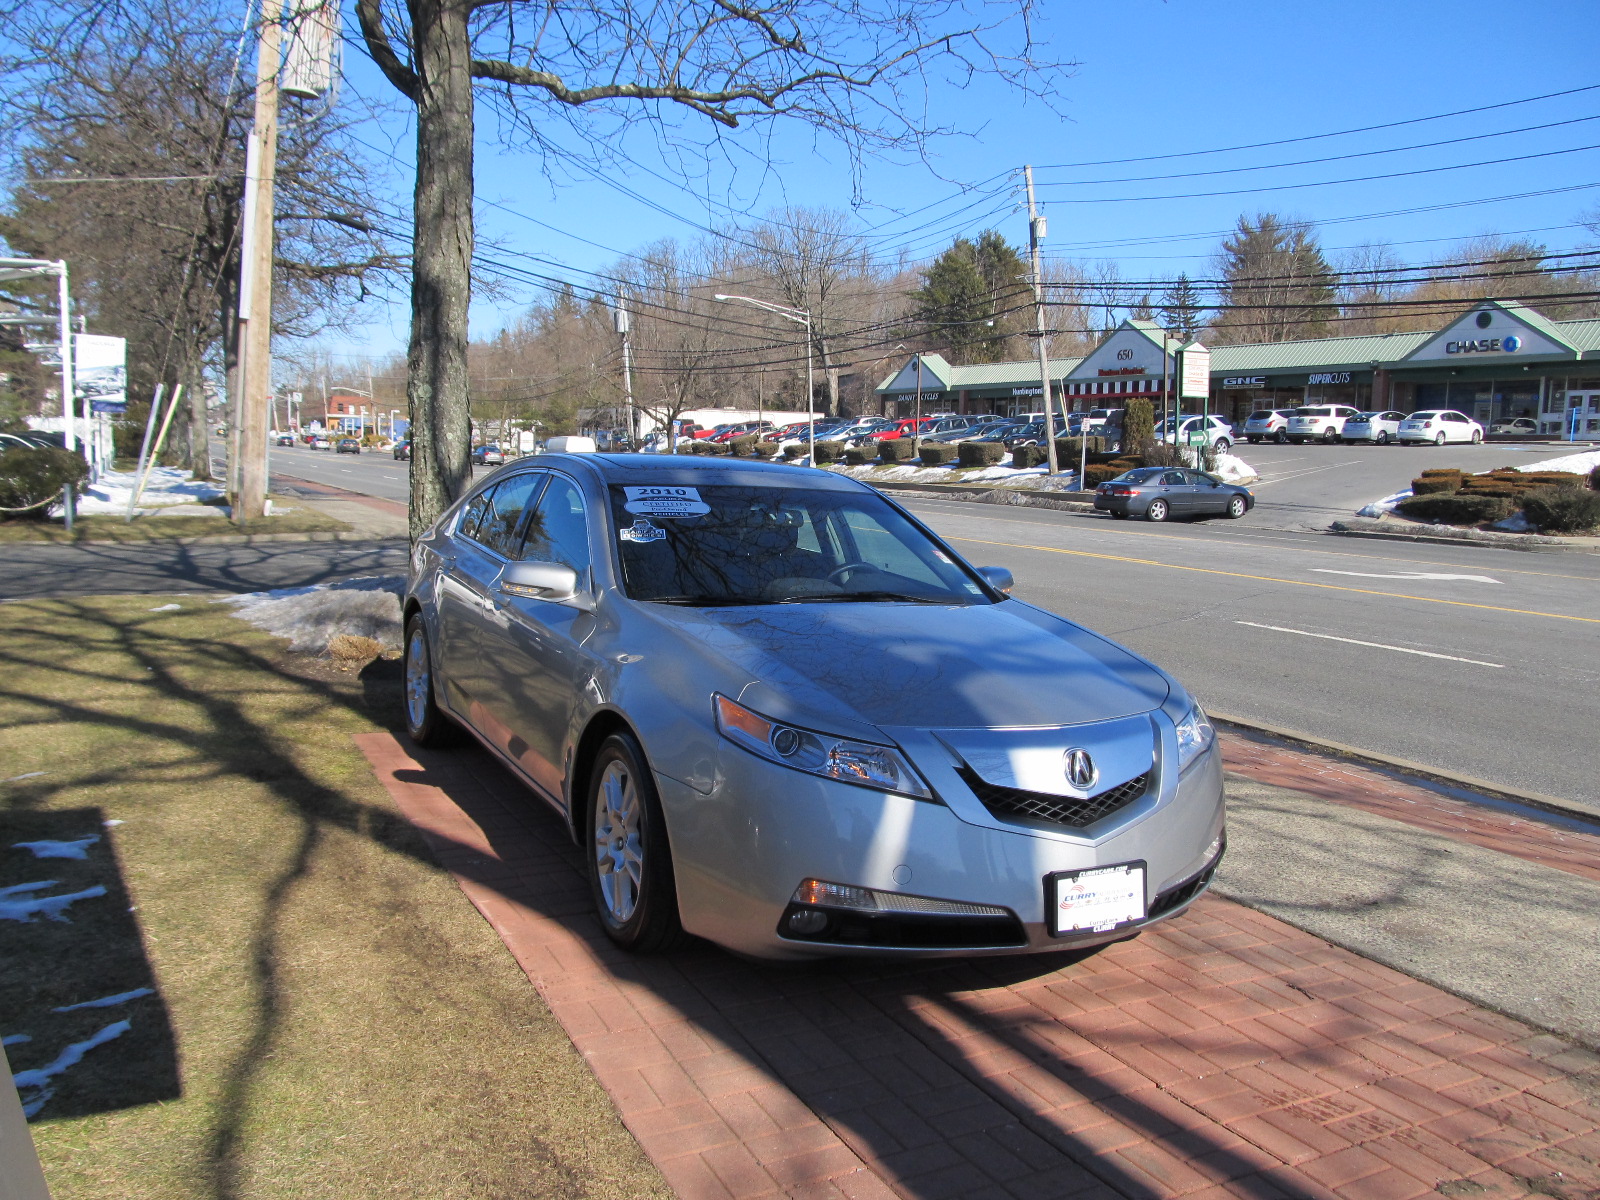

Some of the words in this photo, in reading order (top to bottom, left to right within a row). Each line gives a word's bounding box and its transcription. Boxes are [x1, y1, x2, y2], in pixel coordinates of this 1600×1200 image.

[1445, 337, 1501, 354] CHASE
[1117, 348, 1134, 360] 650
[1223, 376, 1266, 385] GNC
[1307, 372, 1351, 385] SUPERCUTS
[1079, 866, 1128, 877] CURRYCARS.COM
[1064, 892, 1097, 902] CURRY
[1093, 924, 1116, 933] CURRY
